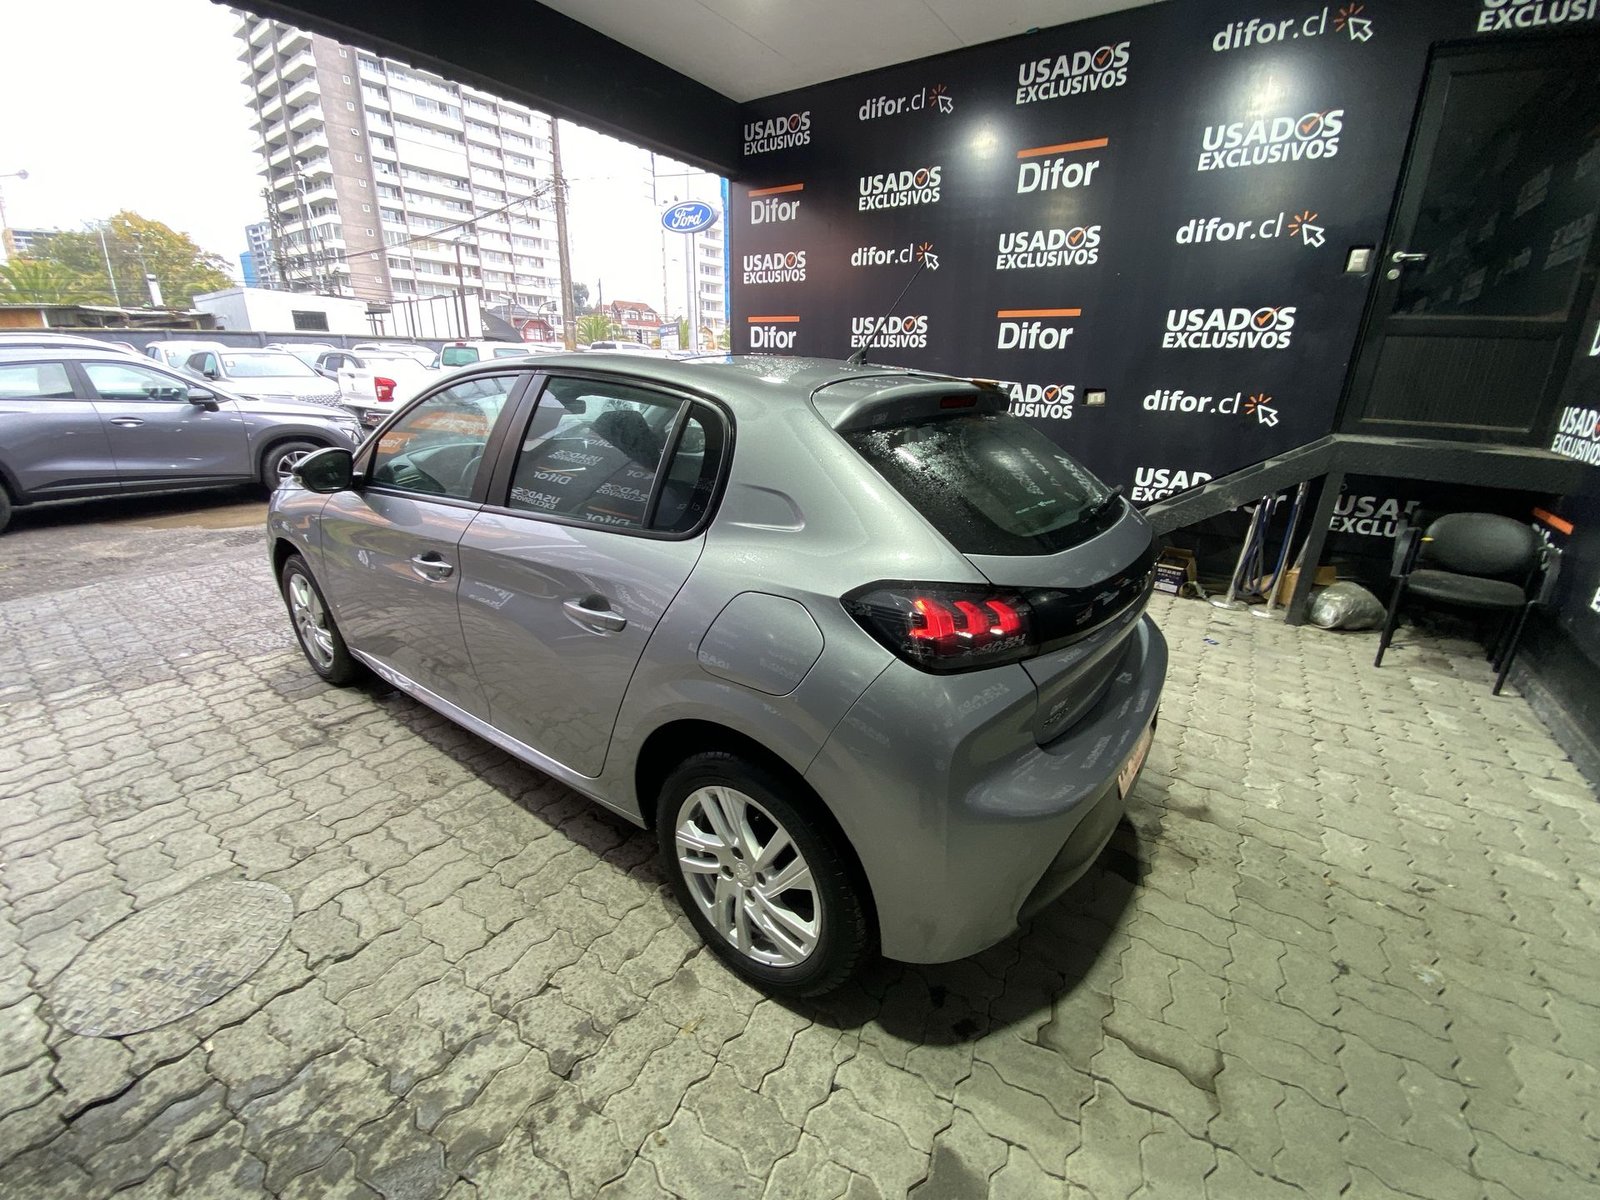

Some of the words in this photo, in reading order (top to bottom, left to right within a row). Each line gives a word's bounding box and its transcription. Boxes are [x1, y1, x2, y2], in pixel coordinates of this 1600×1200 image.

[1477, 0, 1597, 32] EXCLUSI
[1212, 7, 1327, 52] difor.cl
[1018, 41, 1130, 86] USADOS
[1016, 68, 1127, 105] EXCLUSIVOS
[859, 87, 926, 121] difor.cl
[744, 111, 811, 142] USADOS
[1202, 109, 1344, 151] USADOS
[744, 130, 811, 156] EXCLUSIVOS
[1197, 137, 1339, 171] EXCLUSIVOS
[859, 166, 942, 196] USADOS
[1017, 158, 1099, 193] Difor
[751, 198, 800, 225] Difor
[858, 187, 940, 211] EXCLUSIVOS
[672, 206, 702, 228] Ford
[1175, 212, 1284, 244] difor.cl
[998, 225, 1101, 254] USADOS
[743, 251, 806, 271] USADOS
[851, 243, 914, 267] difor.cl
[996, 249, 1098, 270] EXCLUSIVOS
[743, 268, 806, 284] EXCLUSIVOS
[852, 315, 928, 334] USADOS
[1166, 306, 1297, 332] USADOS
[750, 326, 797, 348] Difor
[850, 333, 927, 348] EXCLUSIVOS
[997, 322, 1073, 349] Difor
[1162, 330, 1291, 349] EXCLUSIVOS
[999, 383, 1075, 404] ADOS
[1143, 390, 1242, 414] difor.cl
[1135, 467, 1213, 491] USAD
[1329, 516, 1398, 538] EXCLU
